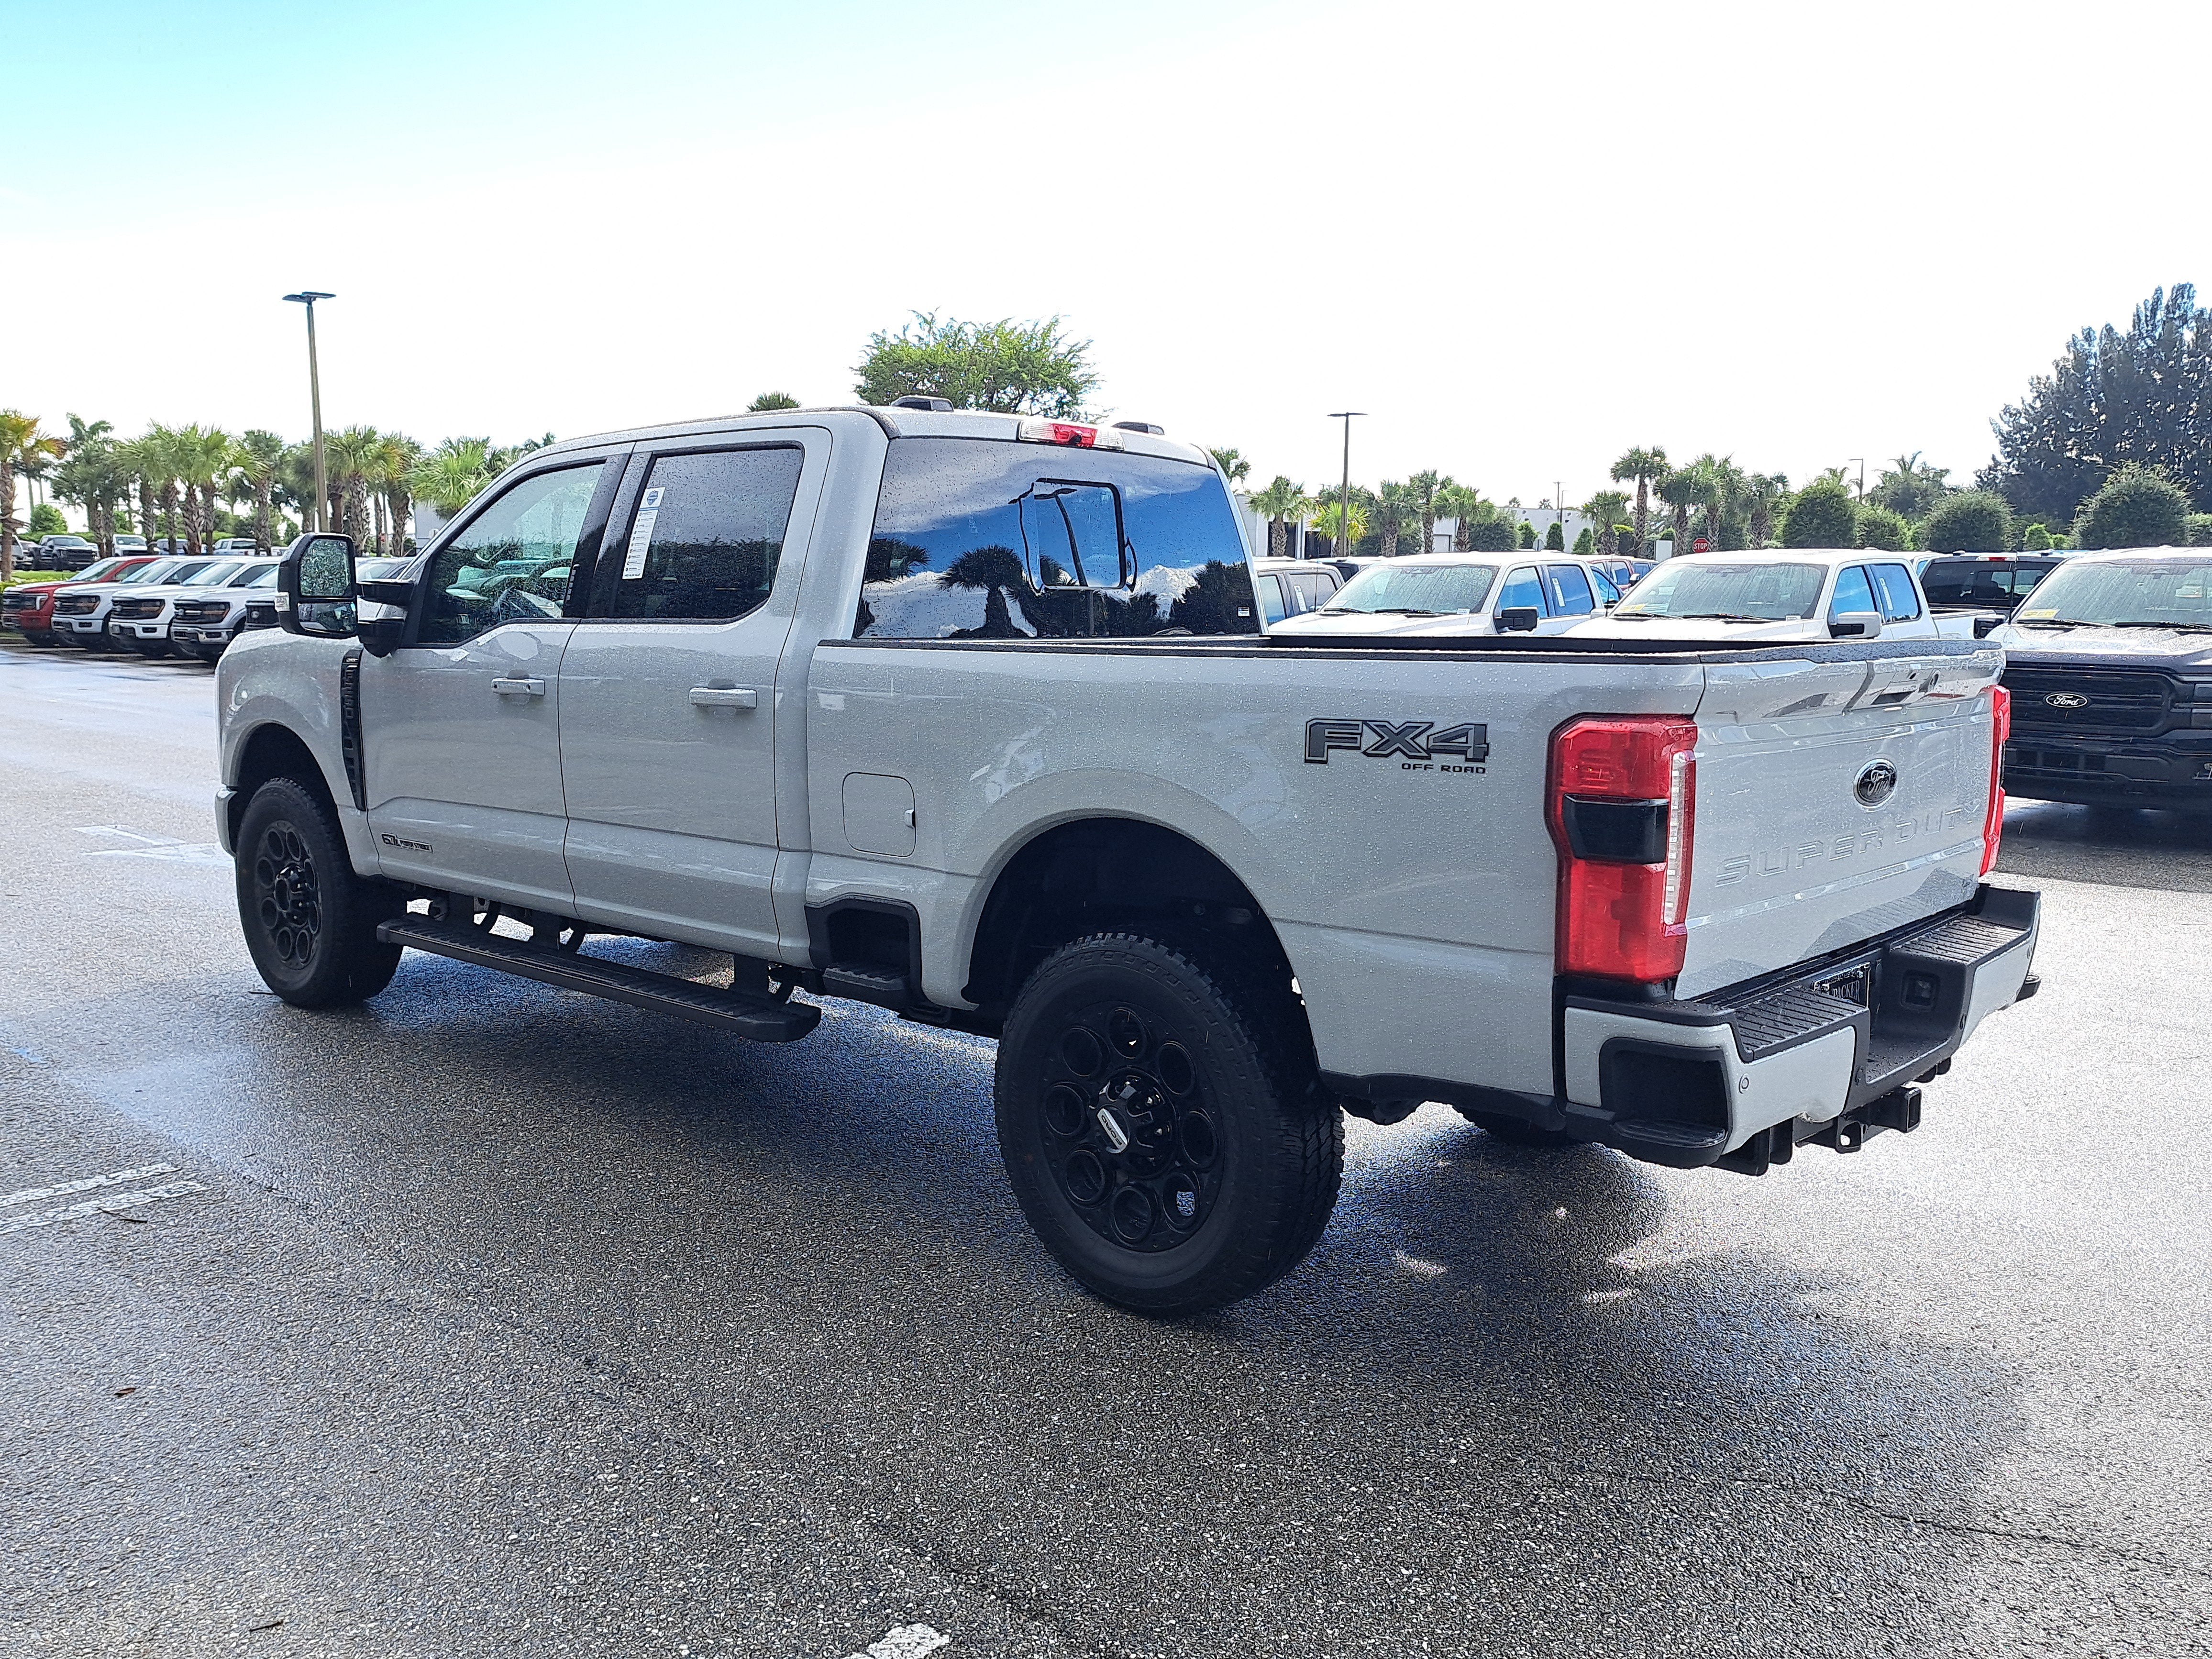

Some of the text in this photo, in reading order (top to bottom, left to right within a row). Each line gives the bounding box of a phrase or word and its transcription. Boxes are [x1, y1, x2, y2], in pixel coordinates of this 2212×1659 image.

[2053, 695, 2079, 706] Ford
[1305, 718, 1490, 764] FX4
[1441, 765, 1486, 774] ROAD
[1714, 800, 1981, 887] SUPER DUTY
[1101, 1115, 1122, 1146] FORD
